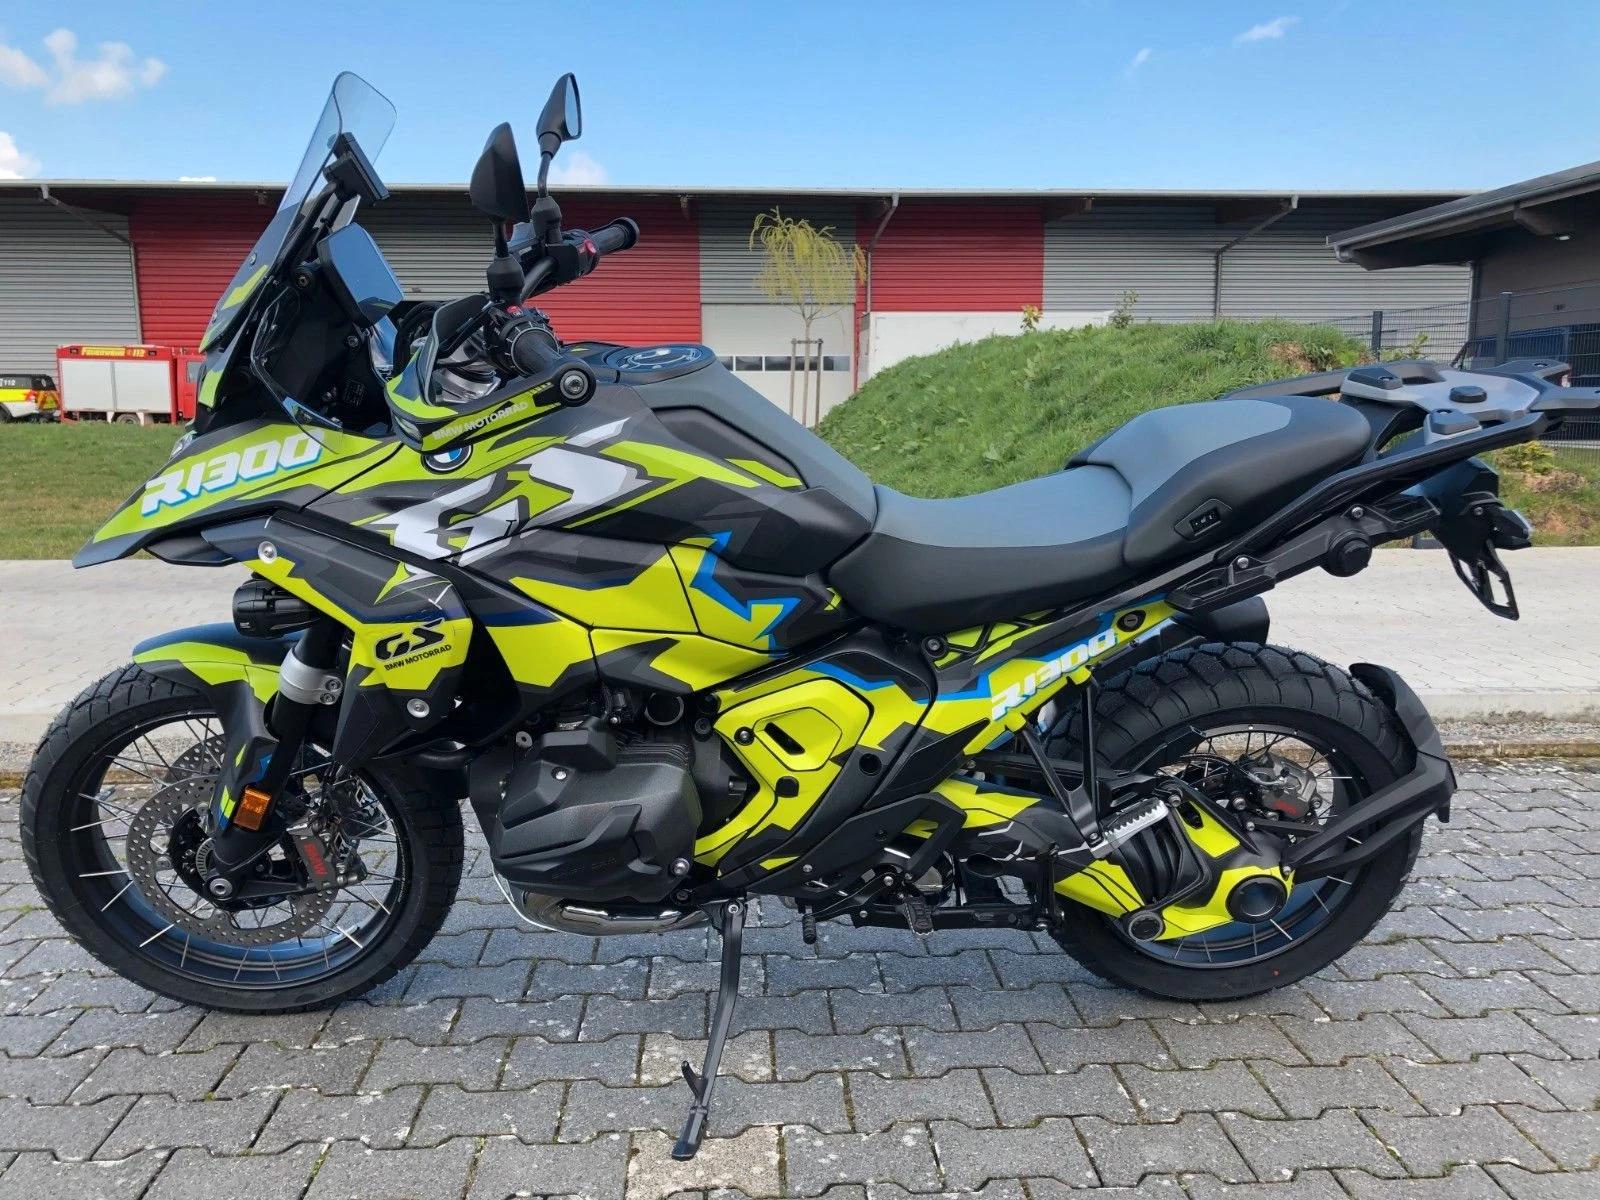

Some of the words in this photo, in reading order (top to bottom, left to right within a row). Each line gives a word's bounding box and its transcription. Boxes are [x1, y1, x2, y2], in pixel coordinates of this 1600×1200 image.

[432, 425, 463, 440] BMW
[464, 401, 529, 432] MOTORRAD
[141, 428, 325, 517] R1300
[374, 617, 445, 661] GS
[384, 659, 404, 671] BMW
[405, 644, 452, 664] MOTORRAD
[991, 628, 1118, 721] R1300
